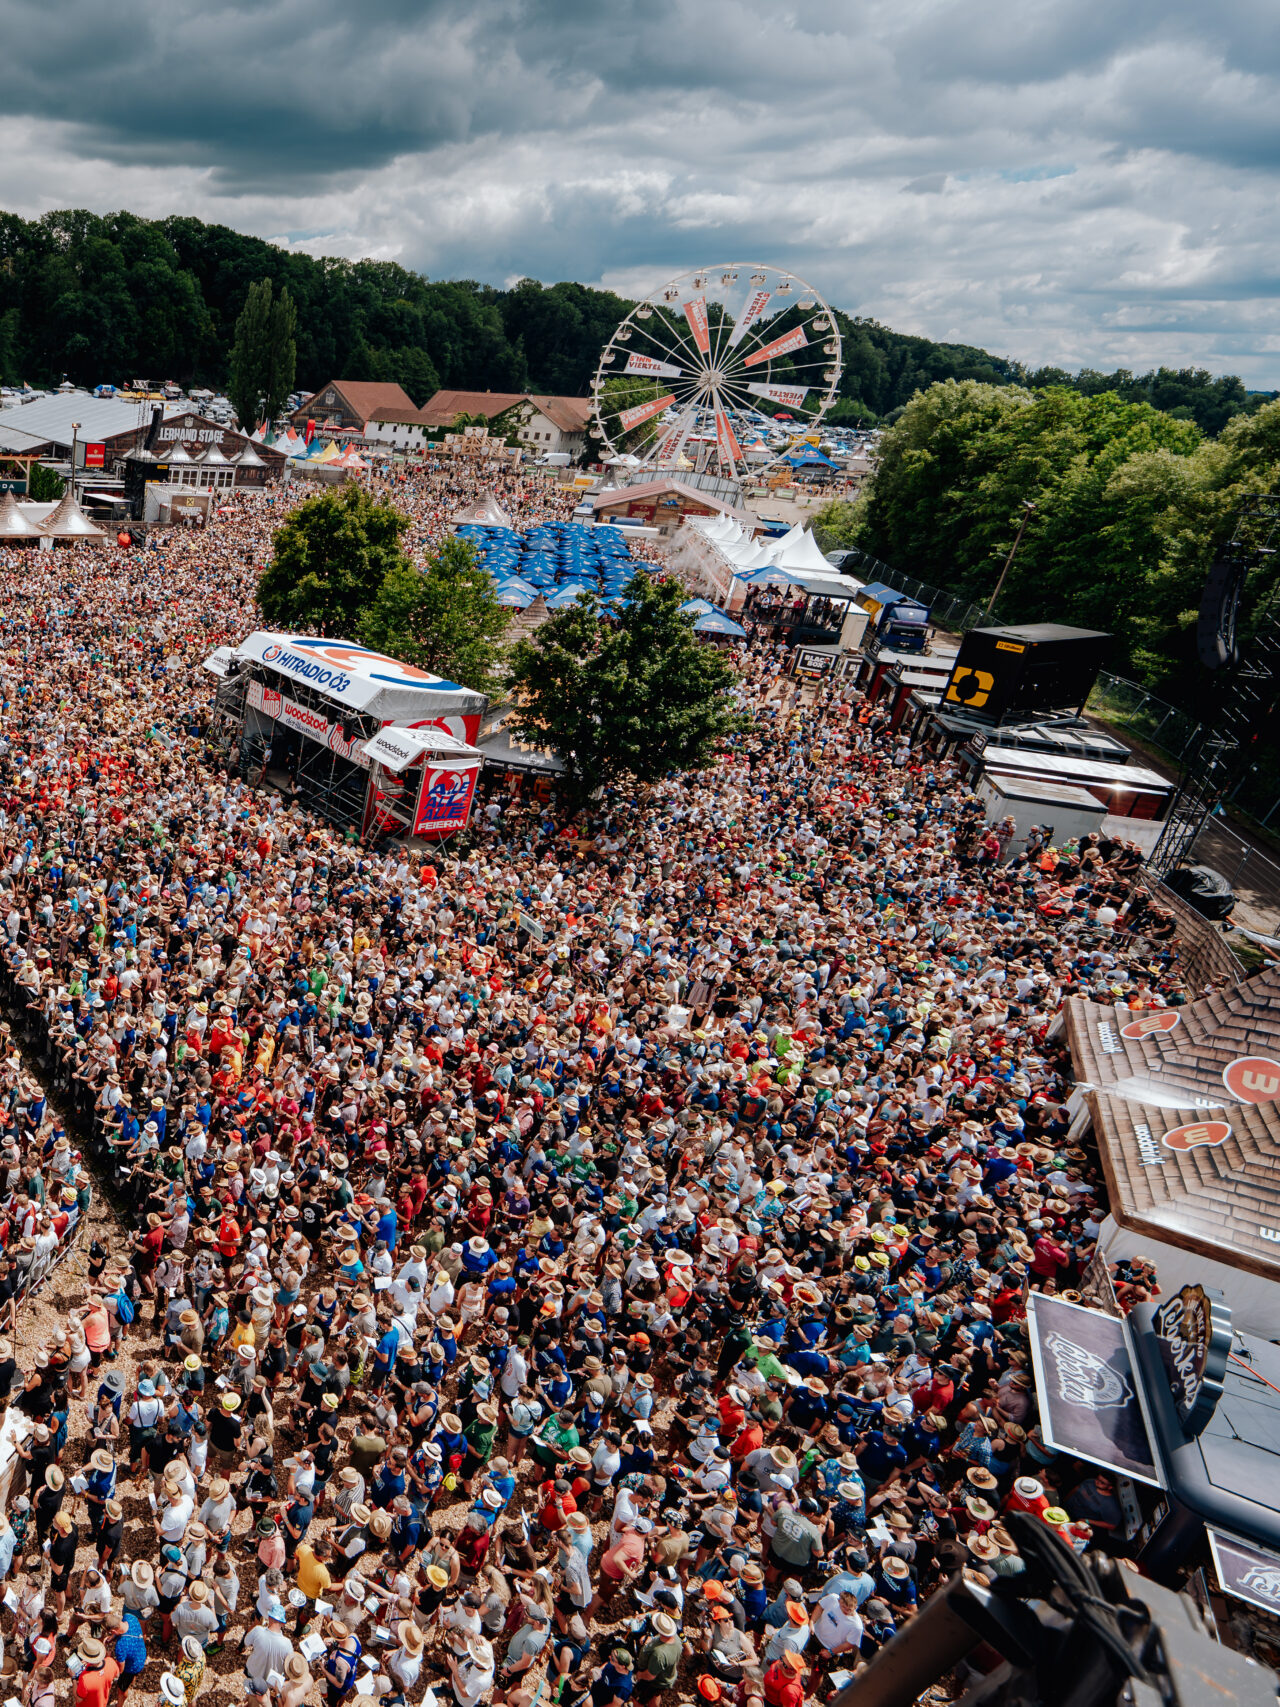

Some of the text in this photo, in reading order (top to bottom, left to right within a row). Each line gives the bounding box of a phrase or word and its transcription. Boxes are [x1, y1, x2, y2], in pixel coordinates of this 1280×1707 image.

[743, 291, 764, 326] VIERTEL
[628, 362, 662, 371] VIERTEL
[158, 427, 225, 443] LERHAND STAGE
[665, 429, 684, 460] VIERTEL
[804, 654, 825, 663] BLAC
[807, 661, 824, 669] BOX
[277, 652, 351, 692] HITRADIO Ö3
[285, 703, 329, 735] woodstock
[376, 737, 410, 760] woodstock
